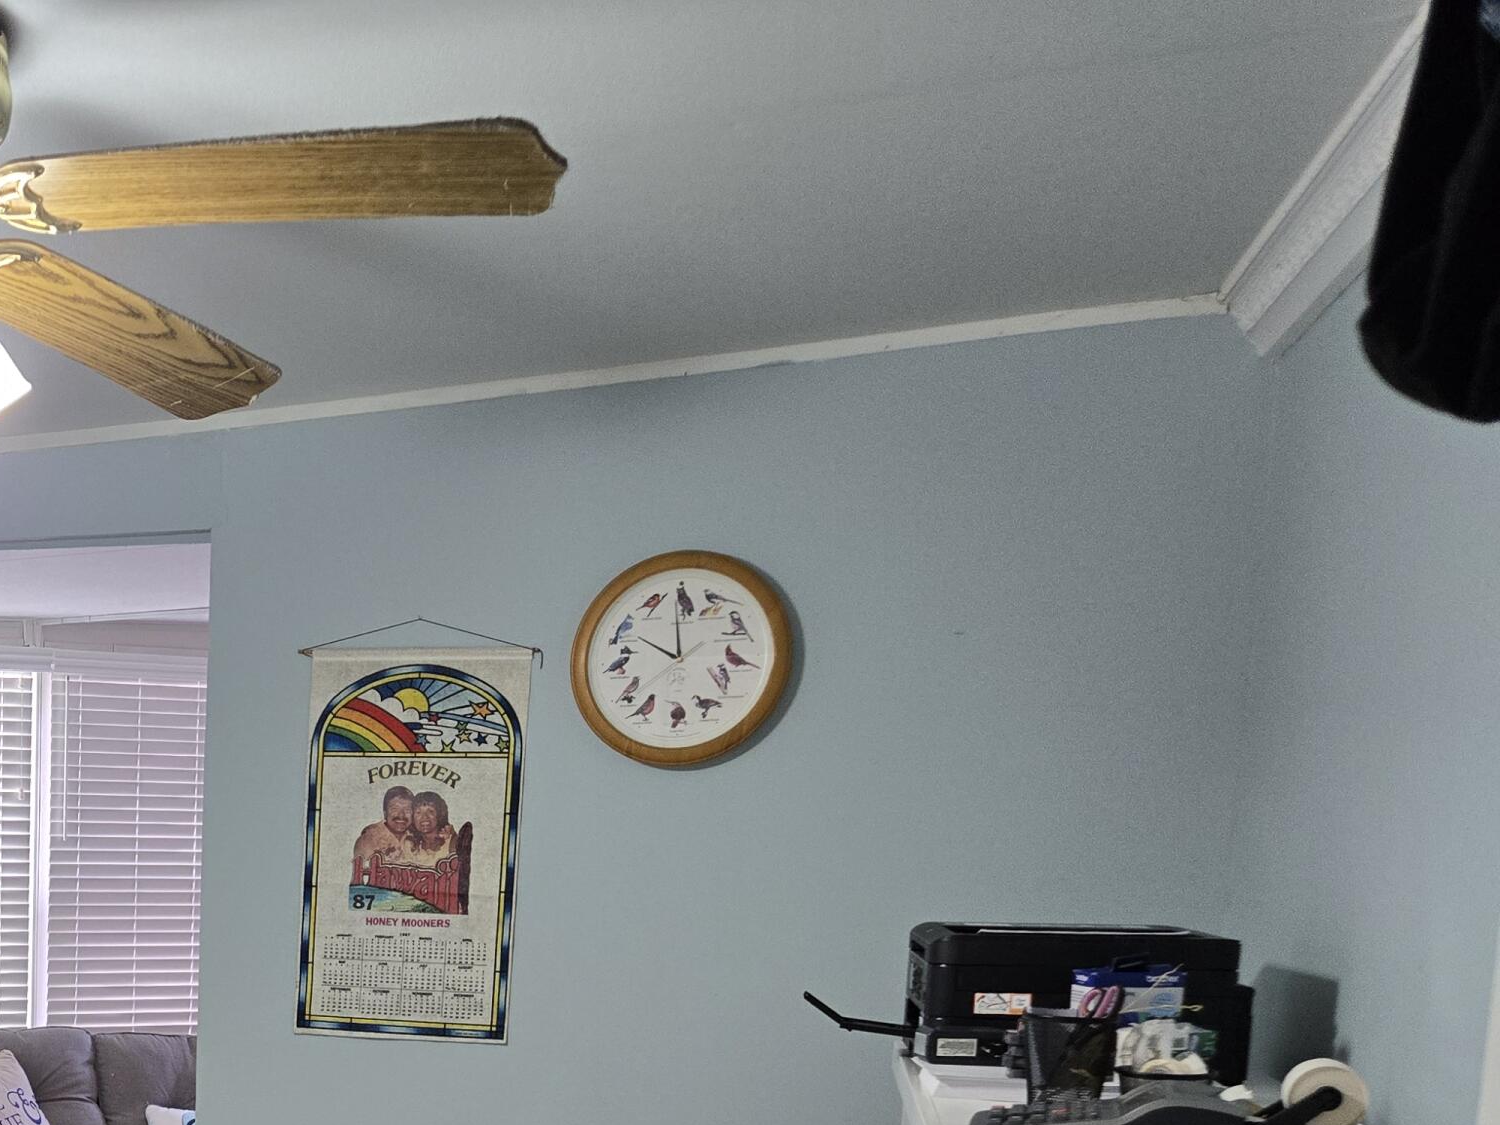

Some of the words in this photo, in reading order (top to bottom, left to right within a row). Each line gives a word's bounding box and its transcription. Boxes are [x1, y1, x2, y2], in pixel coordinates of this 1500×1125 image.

[367, 760, 462, 789] FOREVER
[352, 851, 460, 915] Hawaii
[352, 894, 376, 911] 87
[365, 917, 399, 927] HONEY
[401, 918, 451, 928] MOONERS
